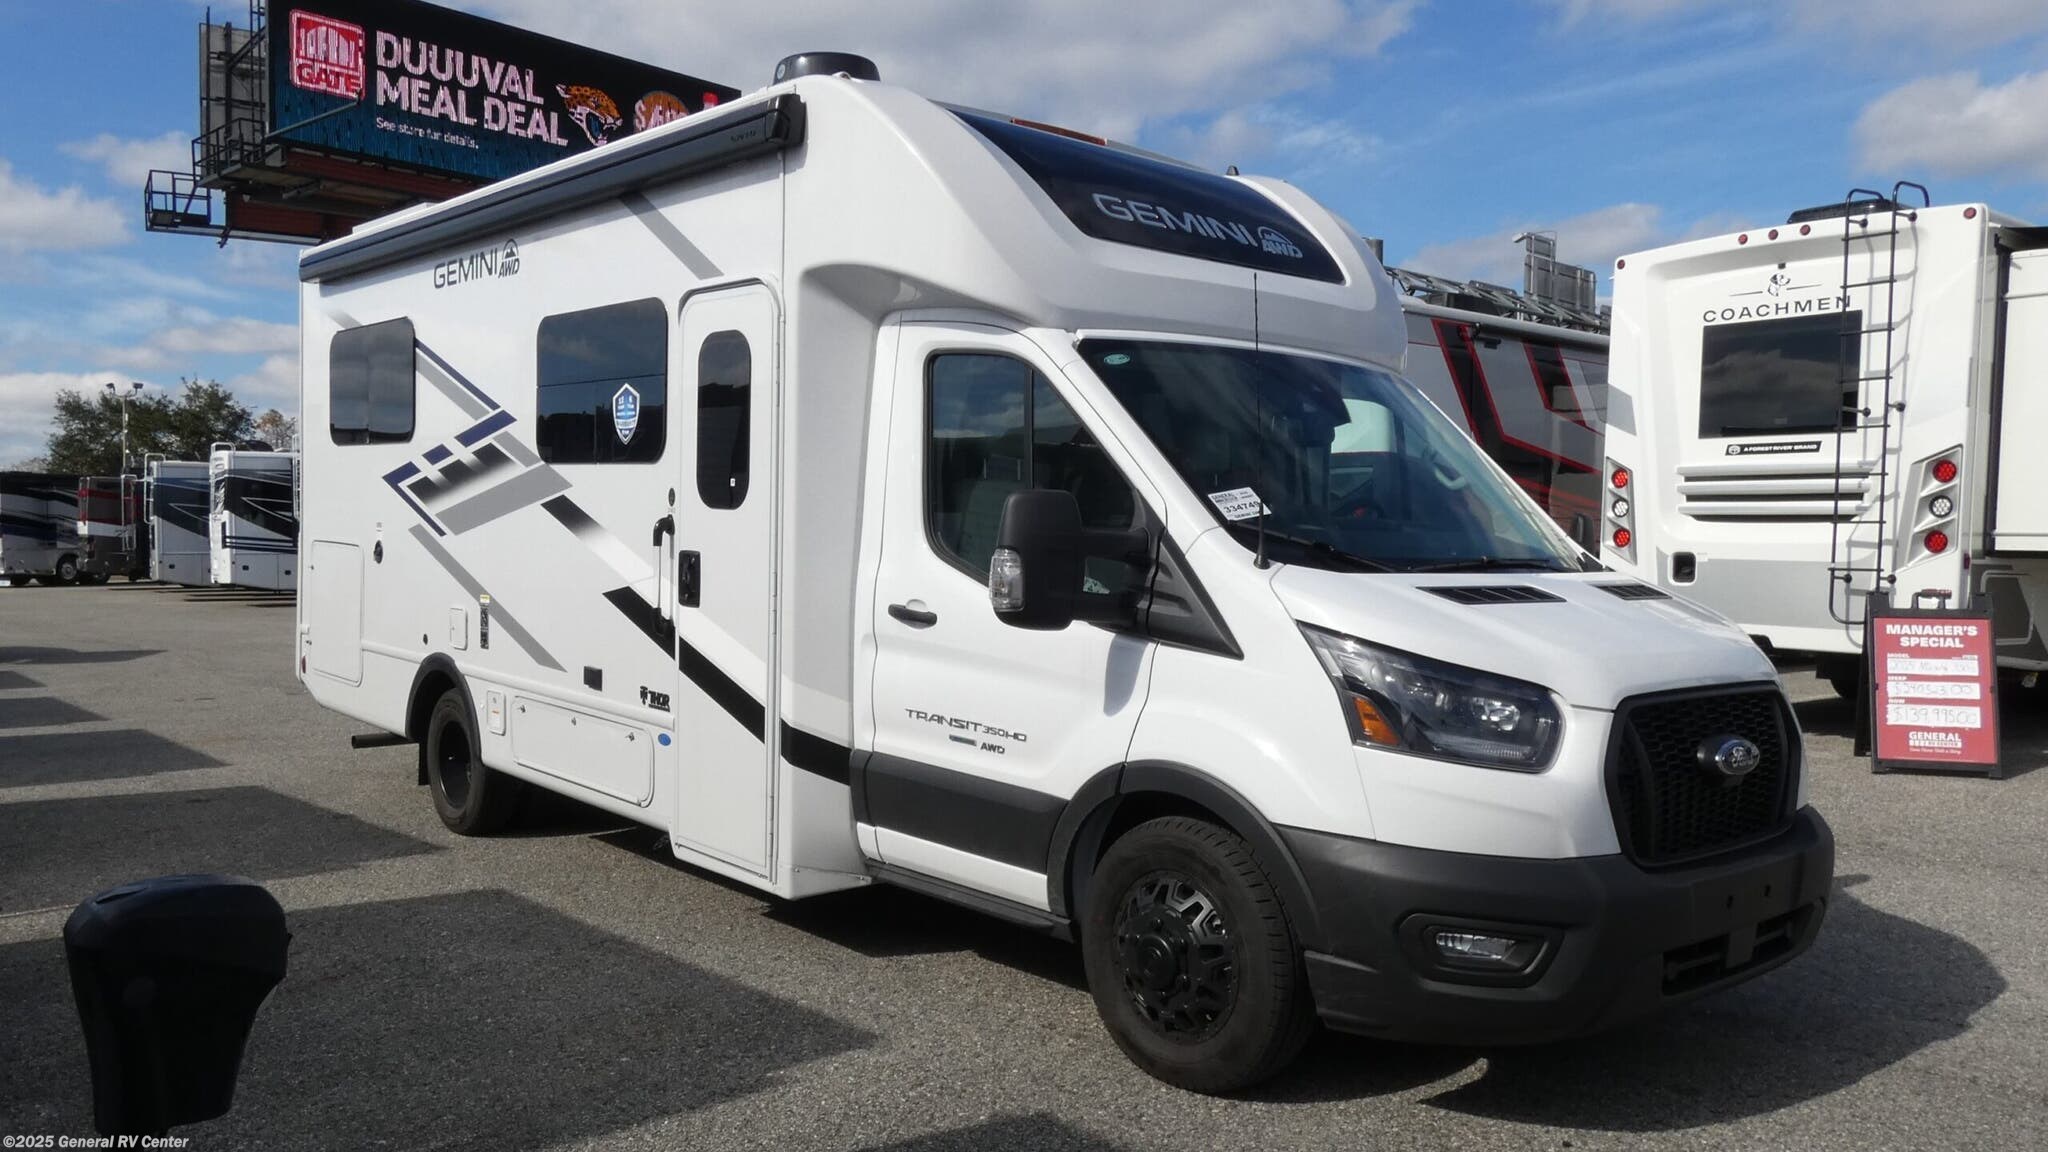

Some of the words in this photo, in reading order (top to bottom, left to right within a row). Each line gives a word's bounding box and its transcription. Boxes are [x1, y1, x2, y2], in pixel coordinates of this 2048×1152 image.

[296, 62, 362, 94] GATE
[376, 30, 544, 104] DUUUVAL
[376, 70, 478, 125] MEAL
[484, 96, 569, 146] DEAL
[376, 117, 396, 131] See
[1092, 193, 1259, 247] GEMINI
[1262, 239, 1303, 258] AWD
[434, 248, 498, 289] GEMINI
[498, 258, 520, 278] AWD
[1703, 295, 1851, 323] COACHMEN
[1886, 624, 1978, 636] MANAGER'S
[1900, 637, 1964, 648] SPECIAL
[905, 708, 982, 732] TRANSIT
[980, 742, 1005, 754] AWD
[1909, 731, 1962, 742] GENERAL
